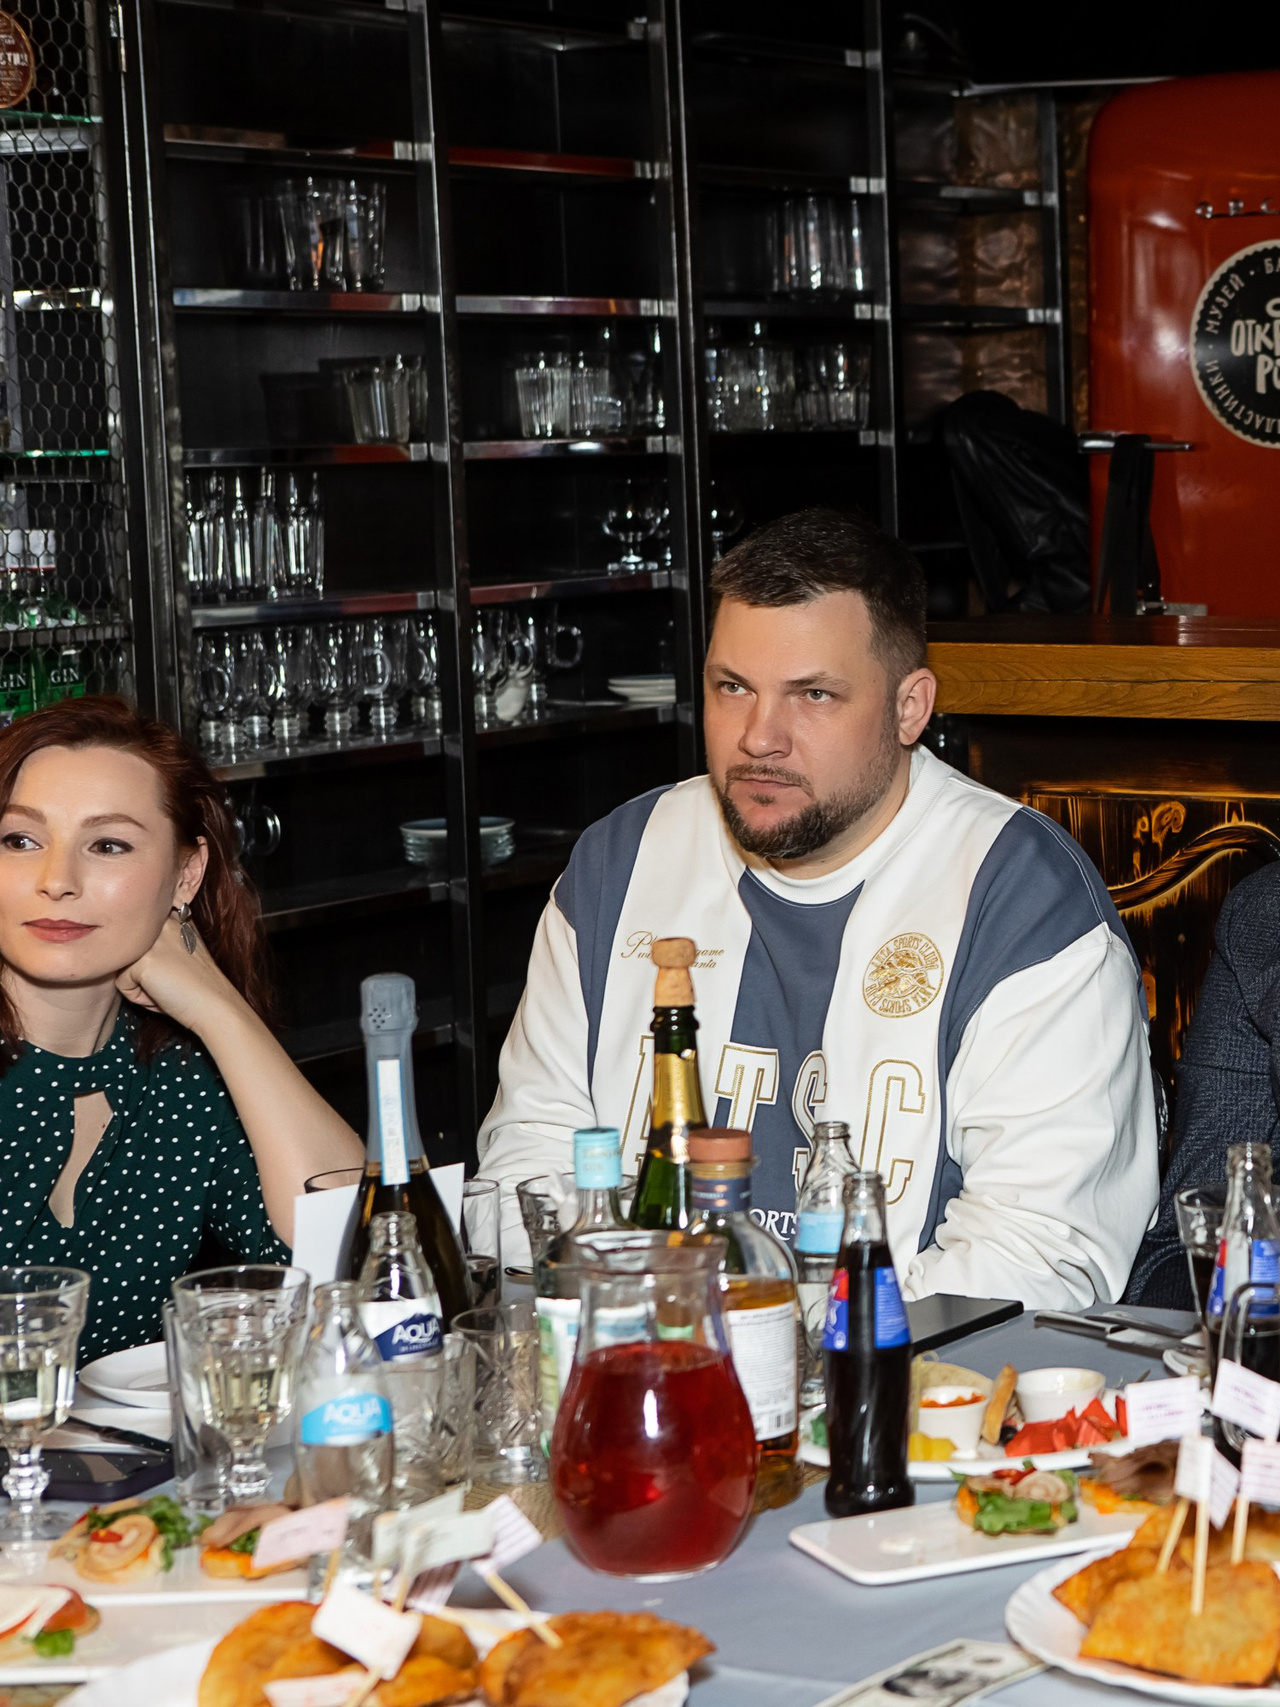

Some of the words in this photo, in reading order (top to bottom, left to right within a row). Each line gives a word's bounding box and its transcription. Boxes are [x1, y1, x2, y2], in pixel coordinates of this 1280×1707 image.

[1205, 273, 1245, 334] МУЗЕЙ
[50, 667, 79, 684] GIN
[893, 935, 922, 950] SPORTS
[919, 942, 939, 971] CLUB
[879, 998, 912, 1014] SPORTS
[391, 1316, 441, 1346] AQUA
[322, 1396, 382, 1427] AQUA
